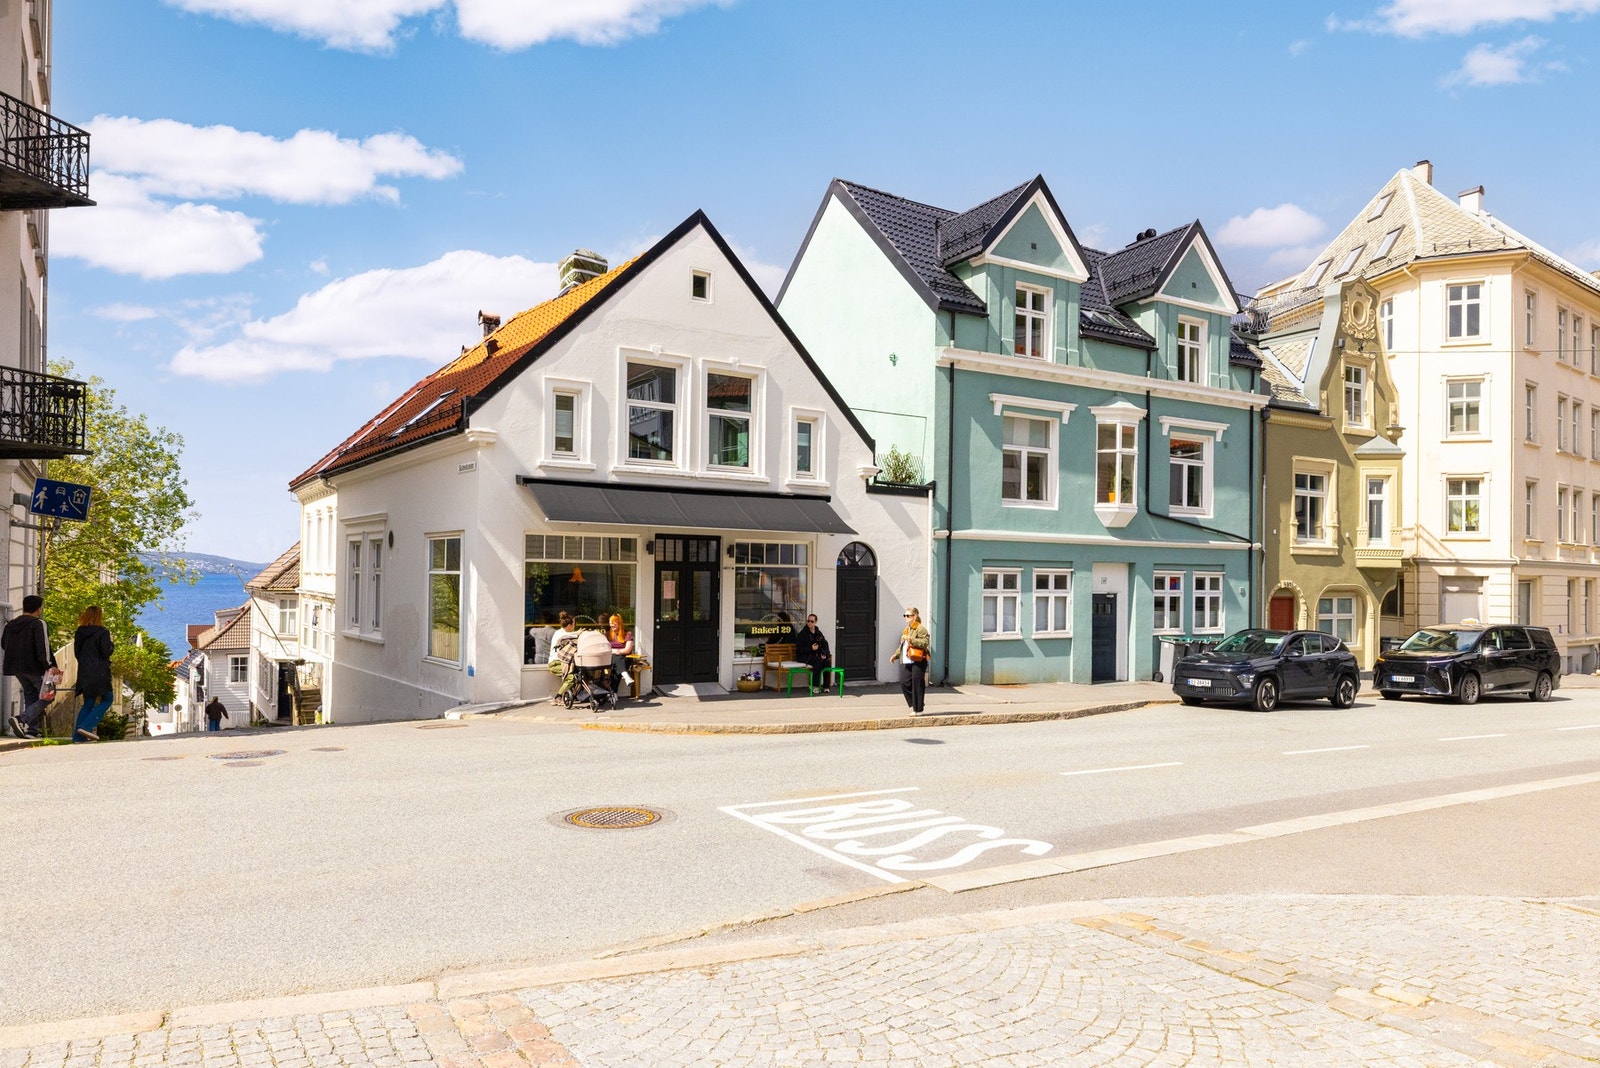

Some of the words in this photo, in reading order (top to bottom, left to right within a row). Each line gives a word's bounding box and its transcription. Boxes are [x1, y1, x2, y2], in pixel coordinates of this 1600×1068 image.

[751, 625, 780, 635] Bakeri
[780, 625, 792, 634] 29
[752, 798, 1054, 871] BUSS
